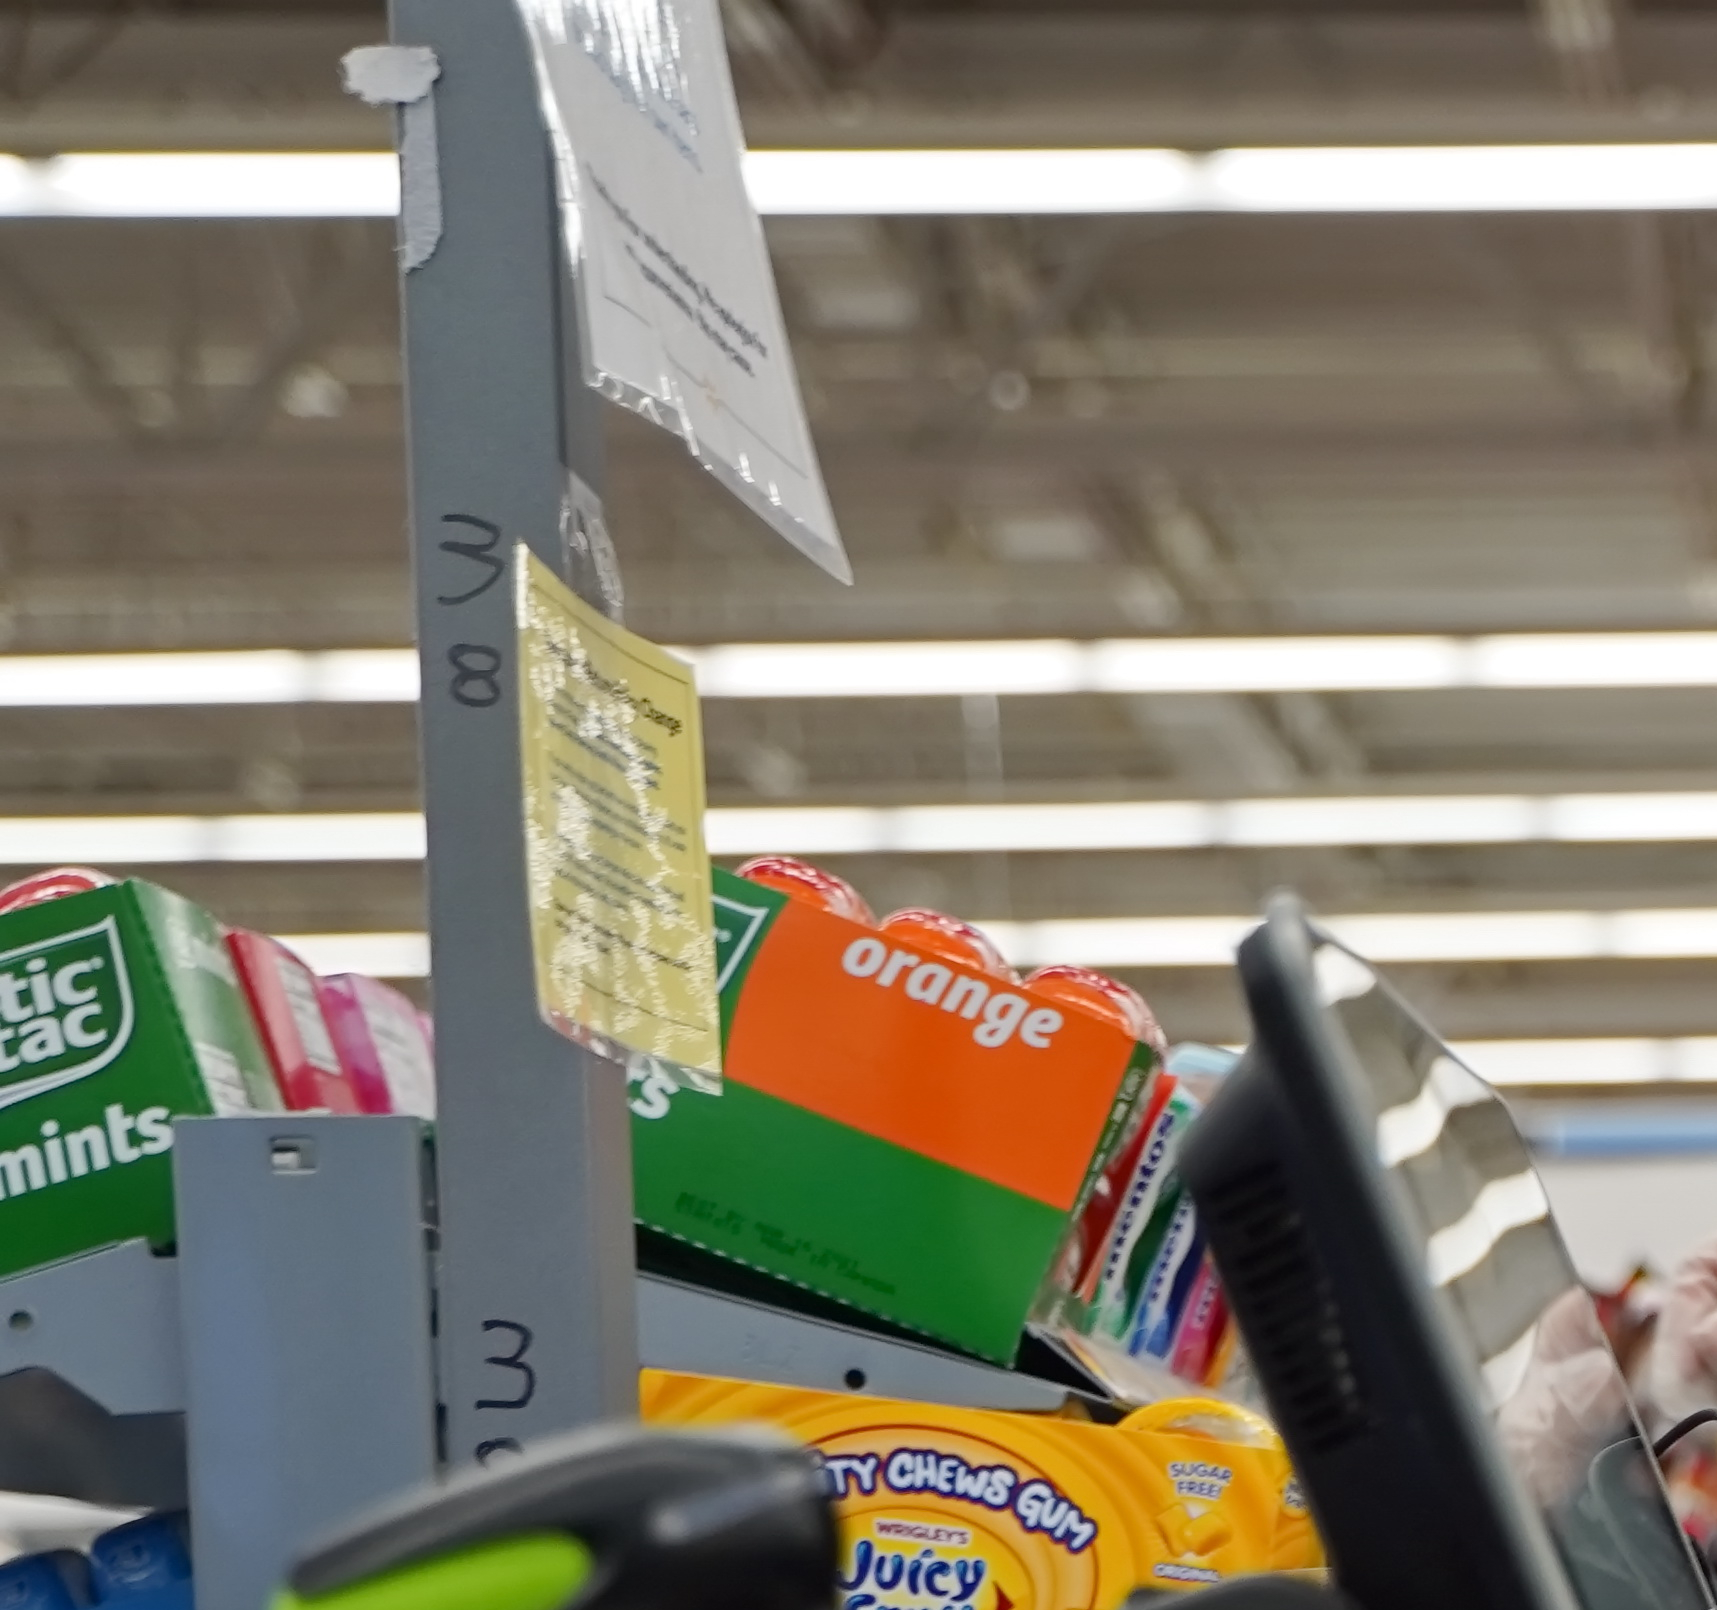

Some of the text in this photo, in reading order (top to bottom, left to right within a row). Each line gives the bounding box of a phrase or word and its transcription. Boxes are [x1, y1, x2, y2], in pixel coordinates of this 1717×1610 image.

[841, 937, 1065, 1049] orange
[886, 1449, 1016, 1508] CHEWS
[1015, 1481, 1096, 1552] GUM
[1169, 1463, 1232, 1481] SUGAR
[876, 1521, 969, 1545] WRIGLEY'S
[837, 1540, 985, 1600] Juicy
